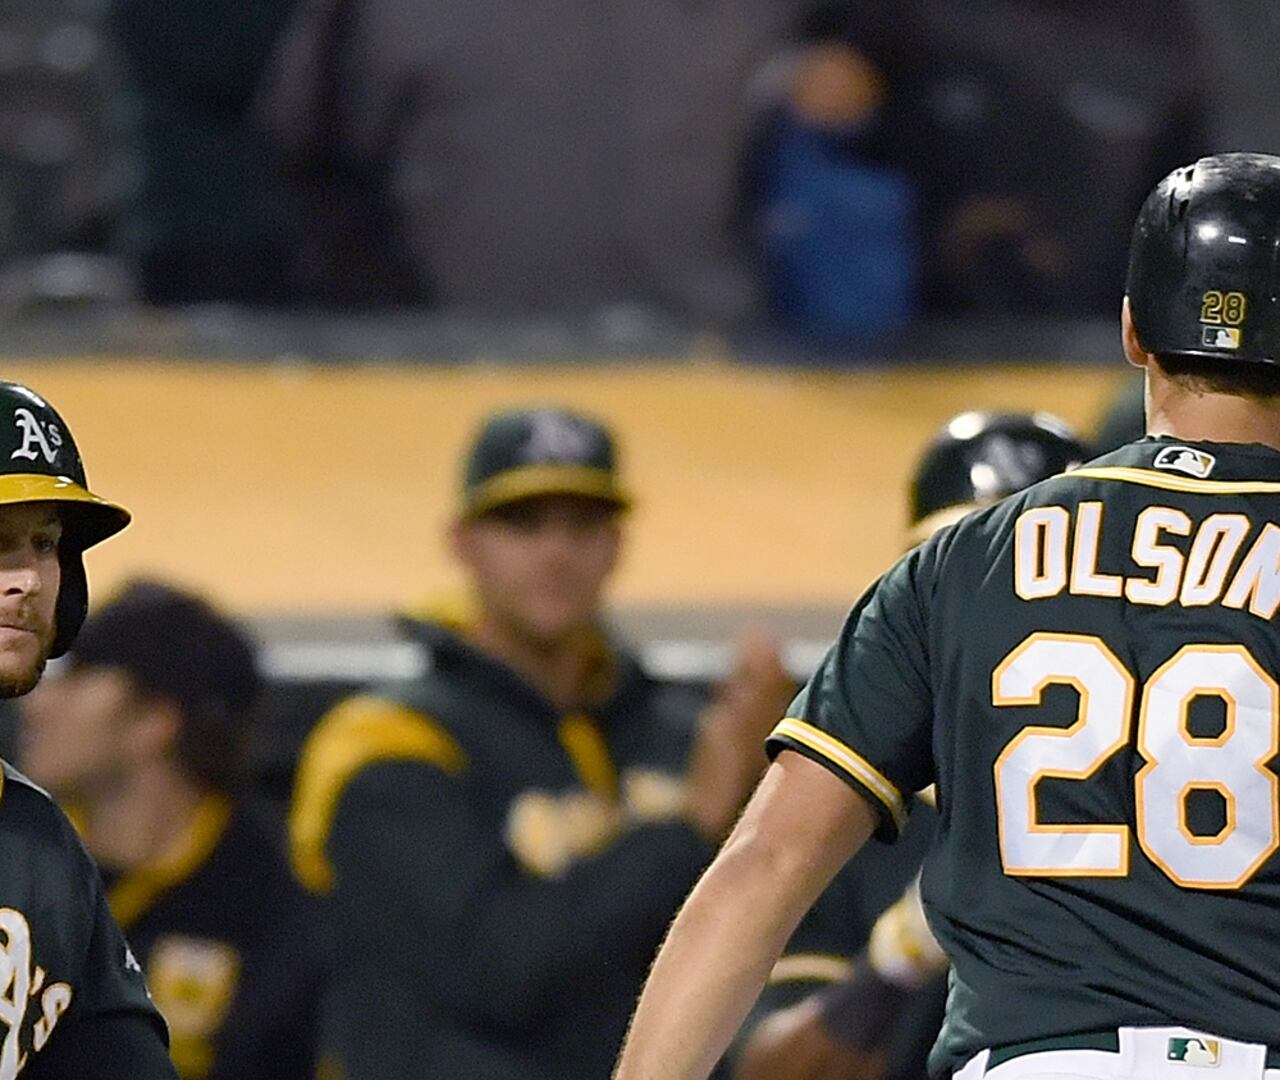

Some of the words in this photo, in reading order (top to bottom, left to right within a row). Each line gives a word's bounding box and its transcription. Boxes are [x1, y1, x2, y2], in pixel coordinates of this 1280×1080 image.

[1200, 290, 1245, 325] 28
[10, 407, 63, 464] A's
[991, 631, 1280, 890] 28
